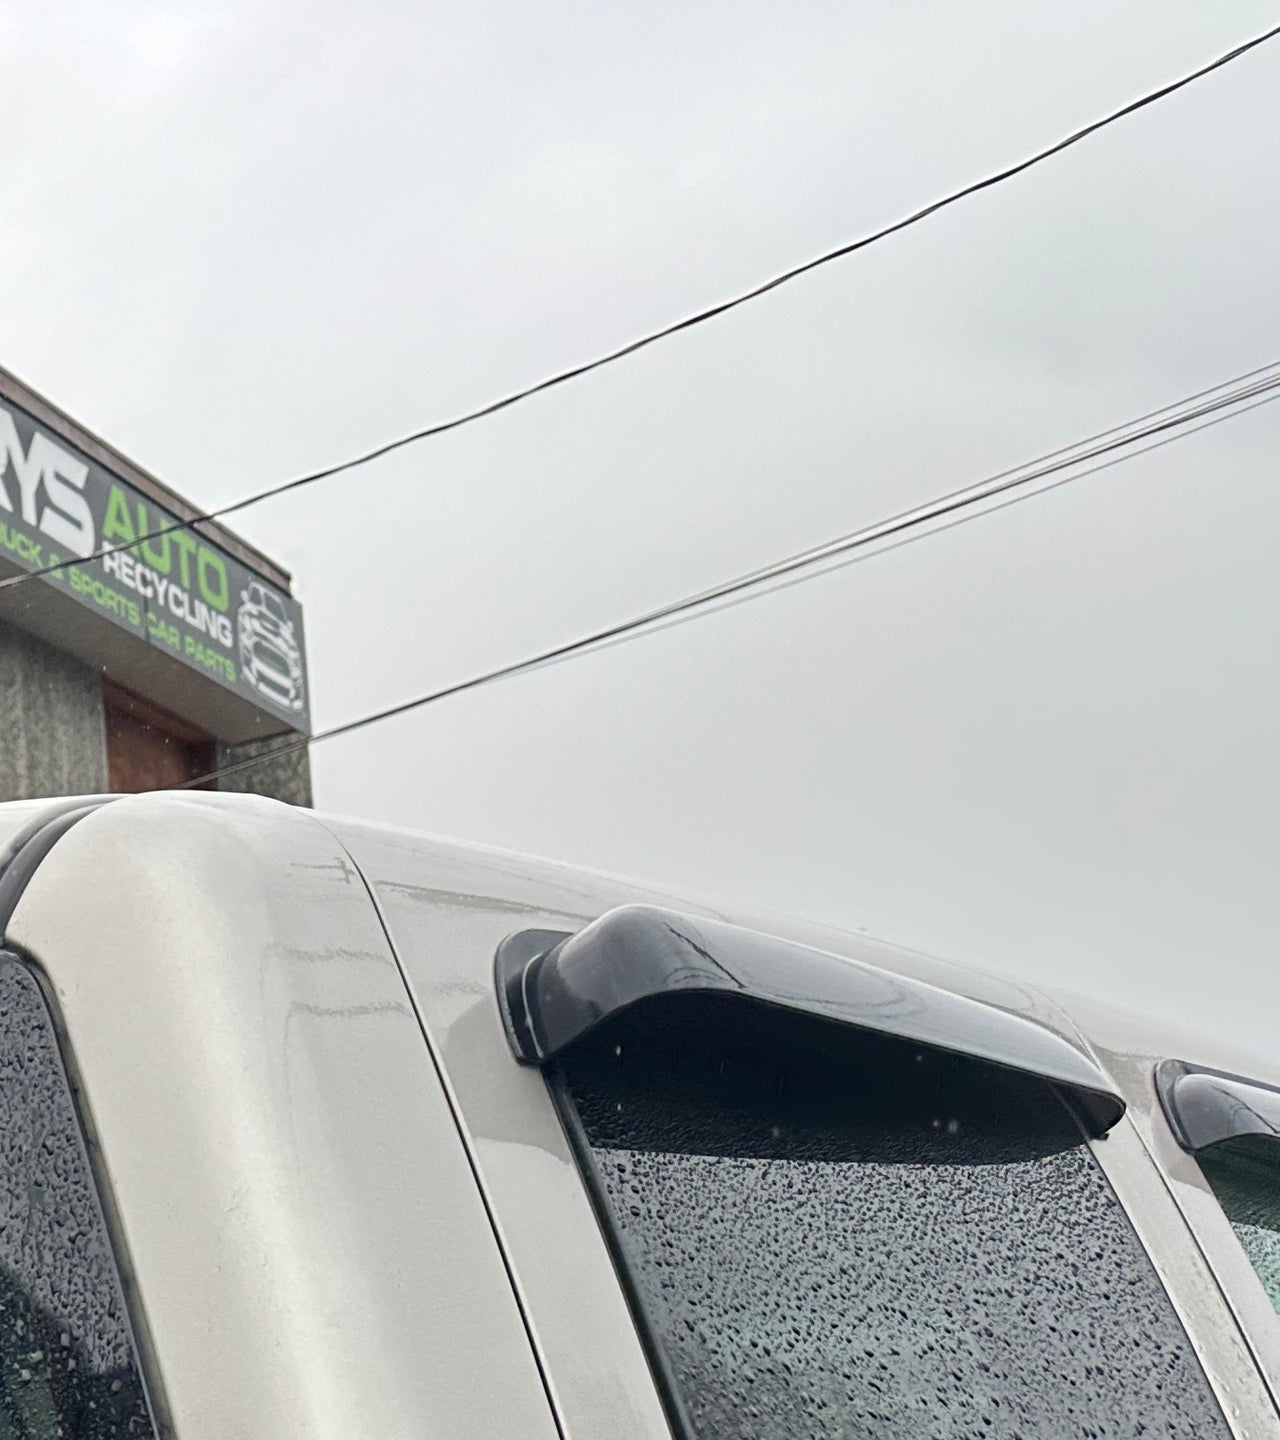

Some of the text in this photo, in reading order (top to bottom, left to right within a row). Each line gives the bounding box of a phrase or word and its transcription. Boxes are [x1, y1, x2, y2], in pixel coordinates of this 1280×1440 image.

[101, 484, 229, 613] AUTO
[101, 540, 233, 648] RECYCLING
[69, 565, 141, 626] SPORTS
[146, 612, 181, 650] CAR
[185, 635, 237, 682] PARTS
